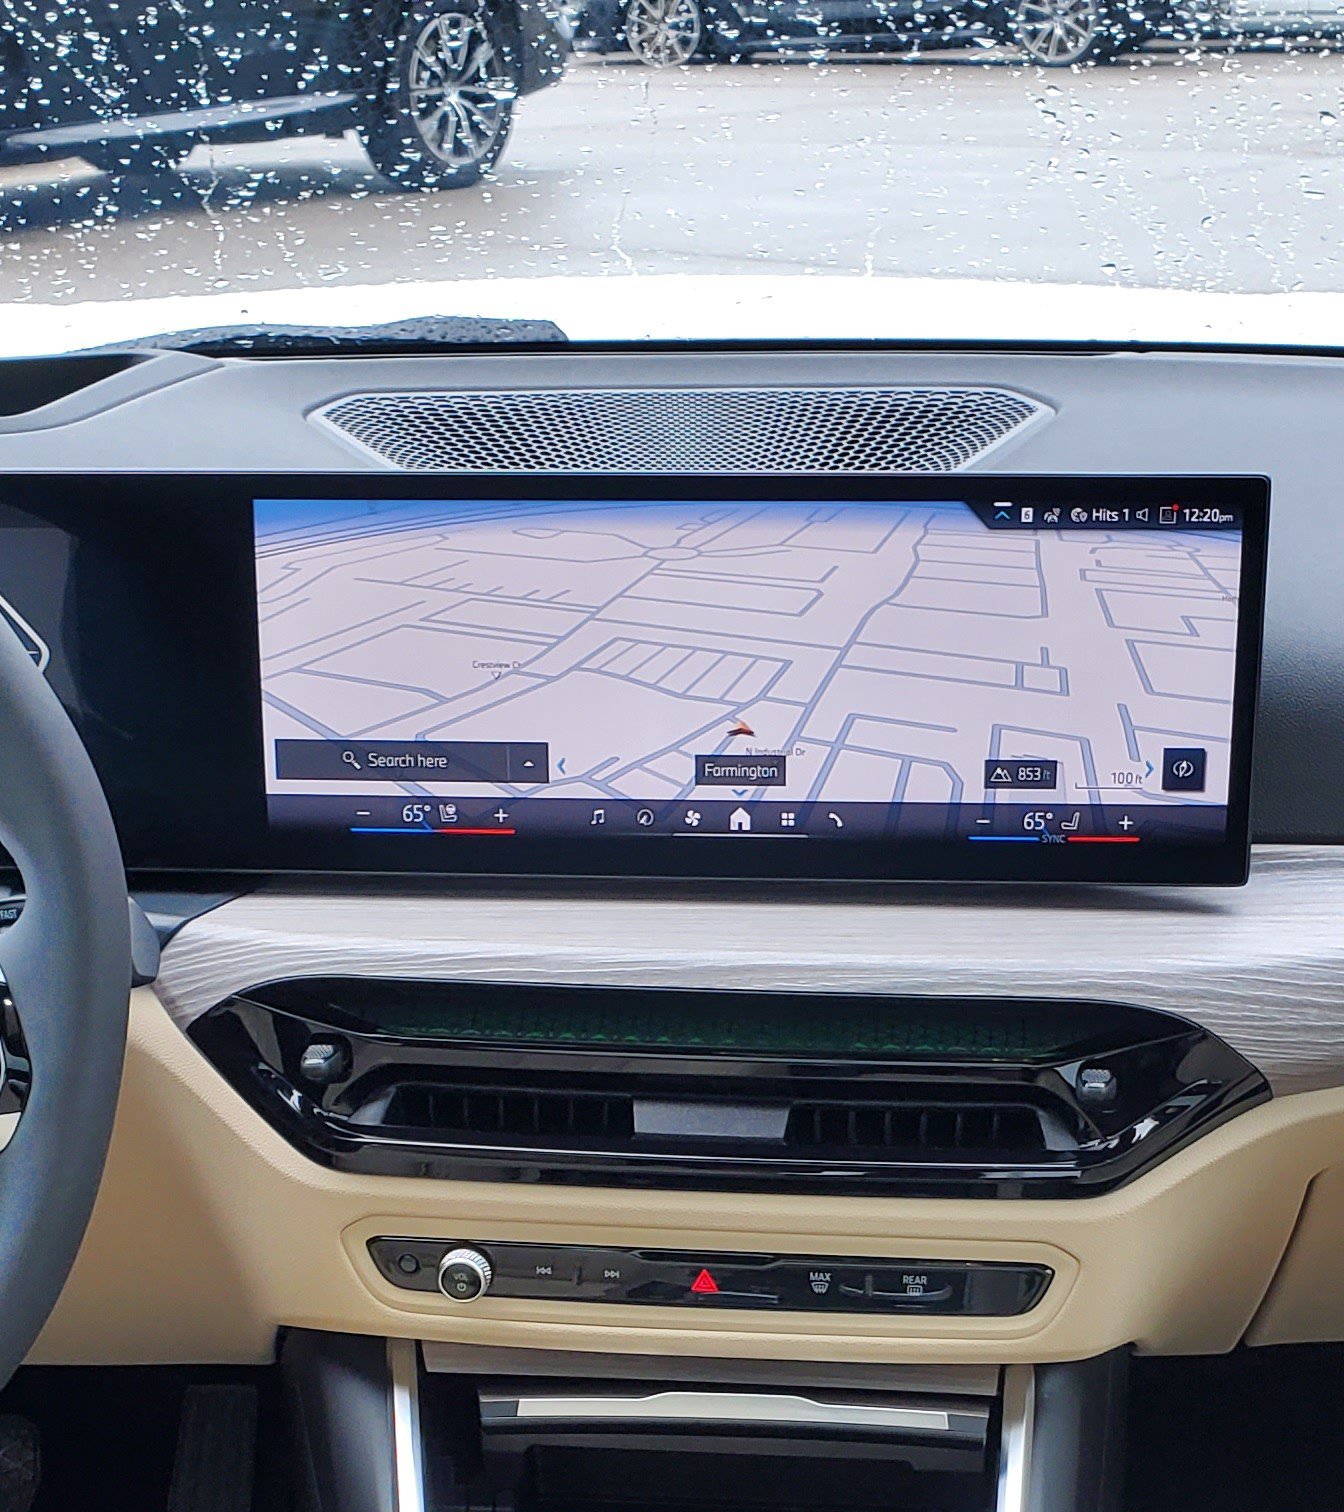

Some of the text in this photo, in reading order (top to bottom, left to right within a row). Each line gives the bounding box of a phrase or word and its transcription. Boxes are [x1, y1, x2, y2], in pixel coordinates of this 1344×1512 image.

[1092, 508, 1131, 522] Hits 1
[795, 747, 807, 757] Dr
[367, 751, 448, 769] Search here
[704, 762, 779, 781] Farmington
[1017, 767, 1052, 782] 853 ft
[1111, 772, 1143, 785] 100 ft
[1041, 833, 1067, 845] SYNC
[809, 1271, 832, 1282] MAX
[902, 1275, 928, 1285] REAR
